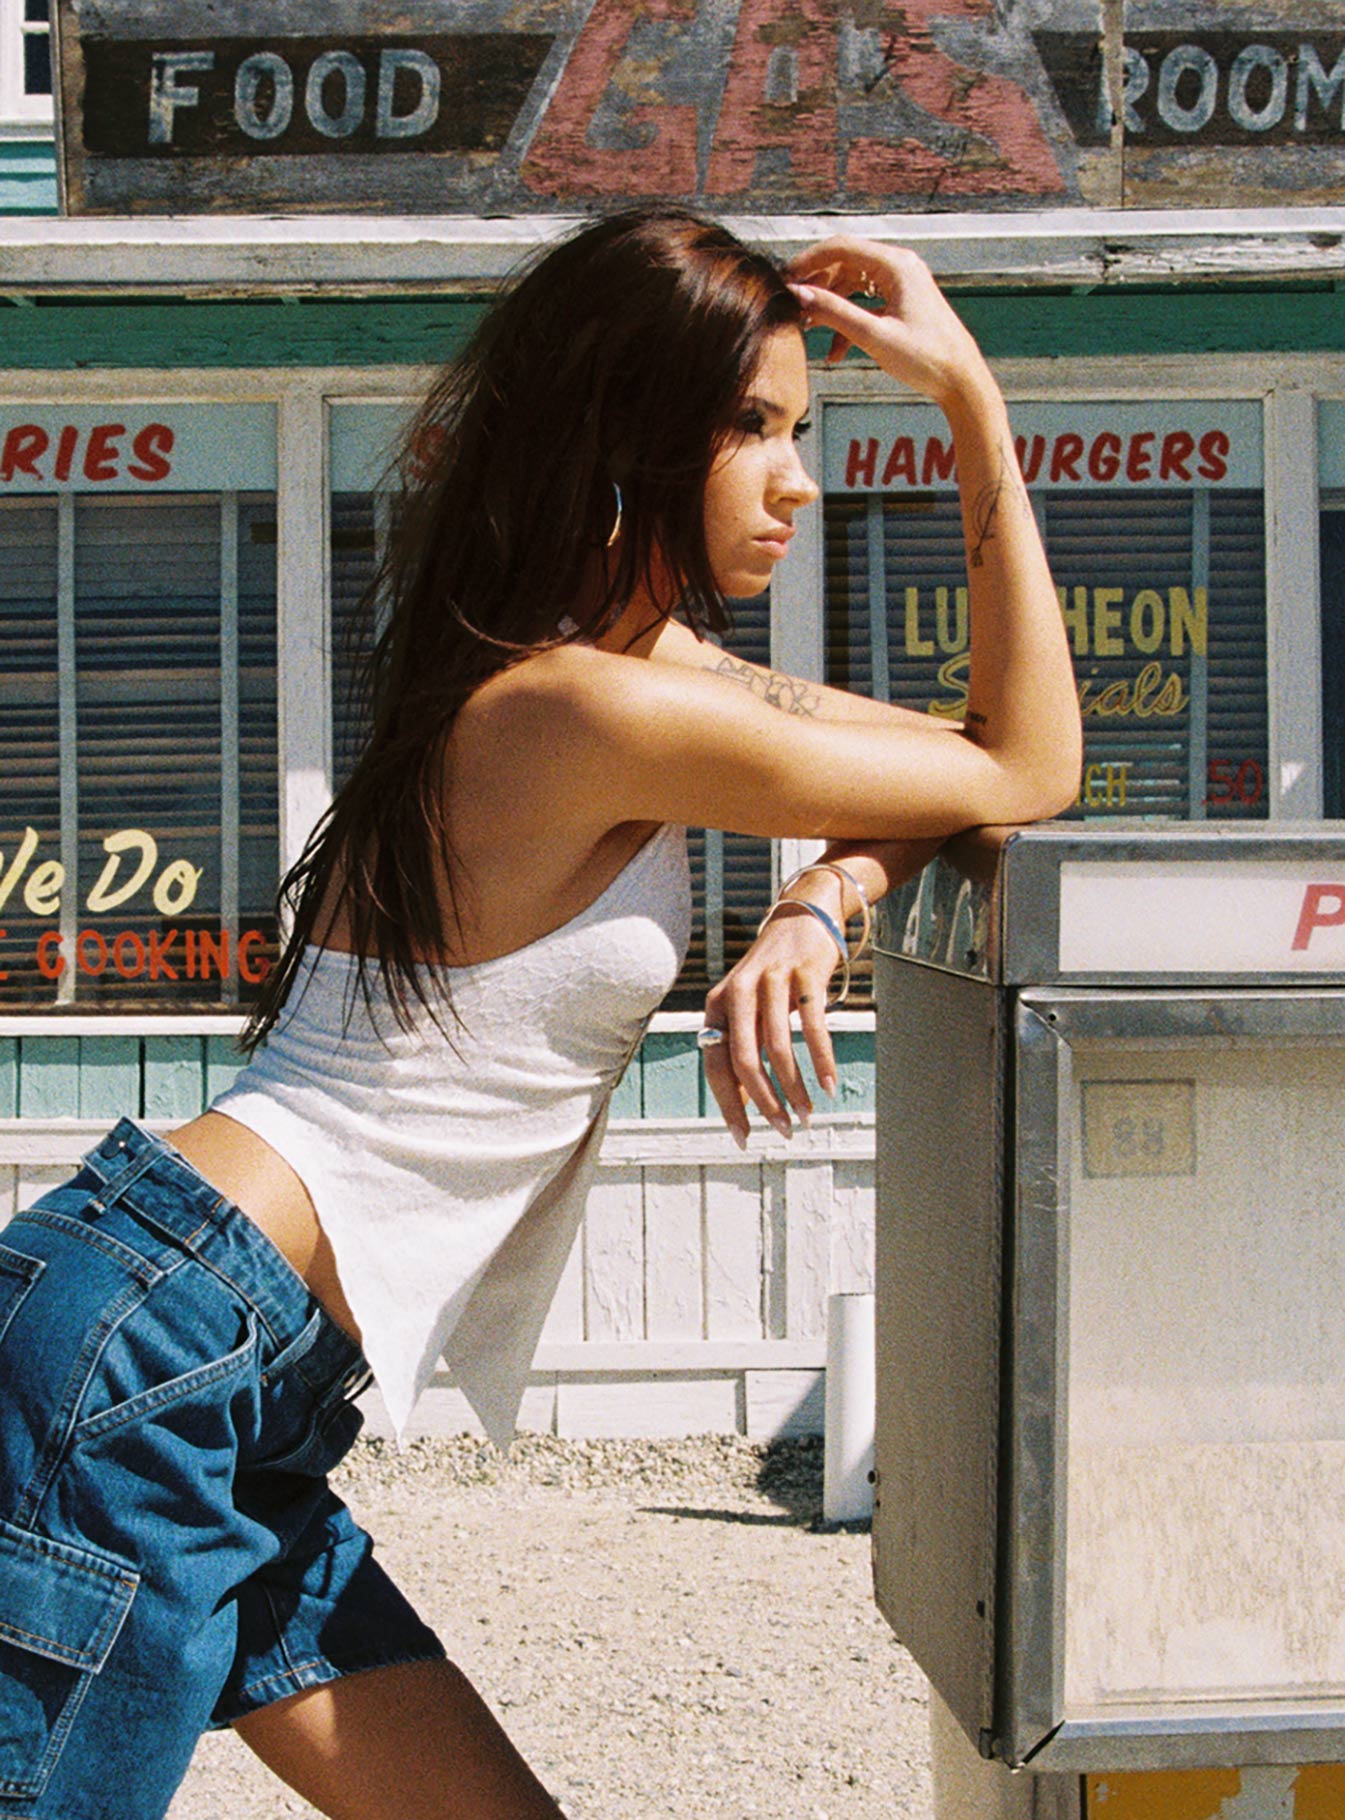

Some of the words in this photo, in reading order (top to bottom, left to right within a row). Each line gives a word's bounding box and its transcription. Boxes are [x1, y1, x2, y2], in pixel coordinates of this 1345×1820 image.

[148, 48, 441, 144] FOOD
[0, 423, 175, 482] RIES
[845, 430, 1230, 487] HAMURGERS
[904, 586, 1208, 656] LUHEON
[928, 652, 1190, 719] Sials
[86, 829, 203, 916] Do
[36, 928, 271, 983] COOKING
